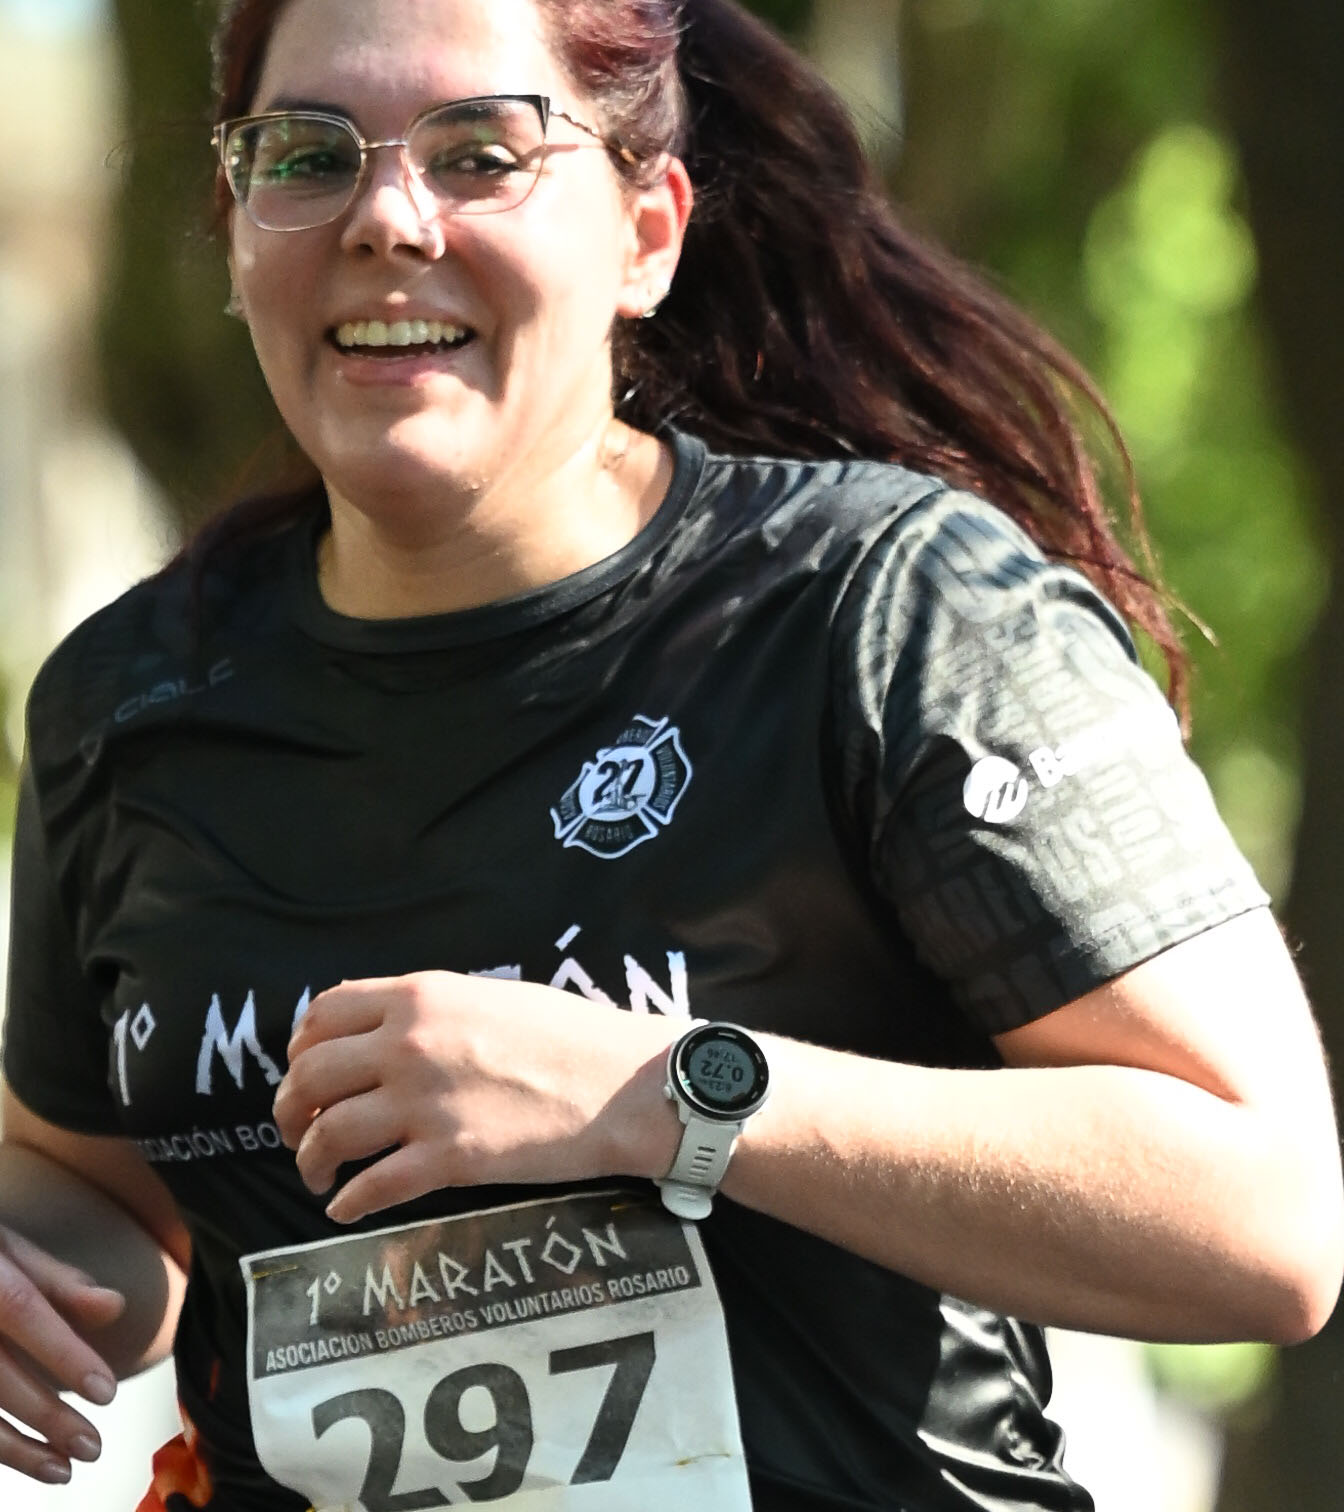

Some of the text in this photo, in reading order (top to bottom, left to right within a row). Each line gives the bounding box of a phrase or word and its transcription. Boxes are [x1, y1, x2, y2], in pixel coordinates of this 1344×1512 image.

[592, 758, 644, 805] 27
[362, 1215, 627, 1316] MARATÓN
[375, 1310, 478, 1349] BOMBEROS
[480, 1283, 605, 1325] VOLUNTARIOS
[607, 1266, 690, 1299] ROSARIO
